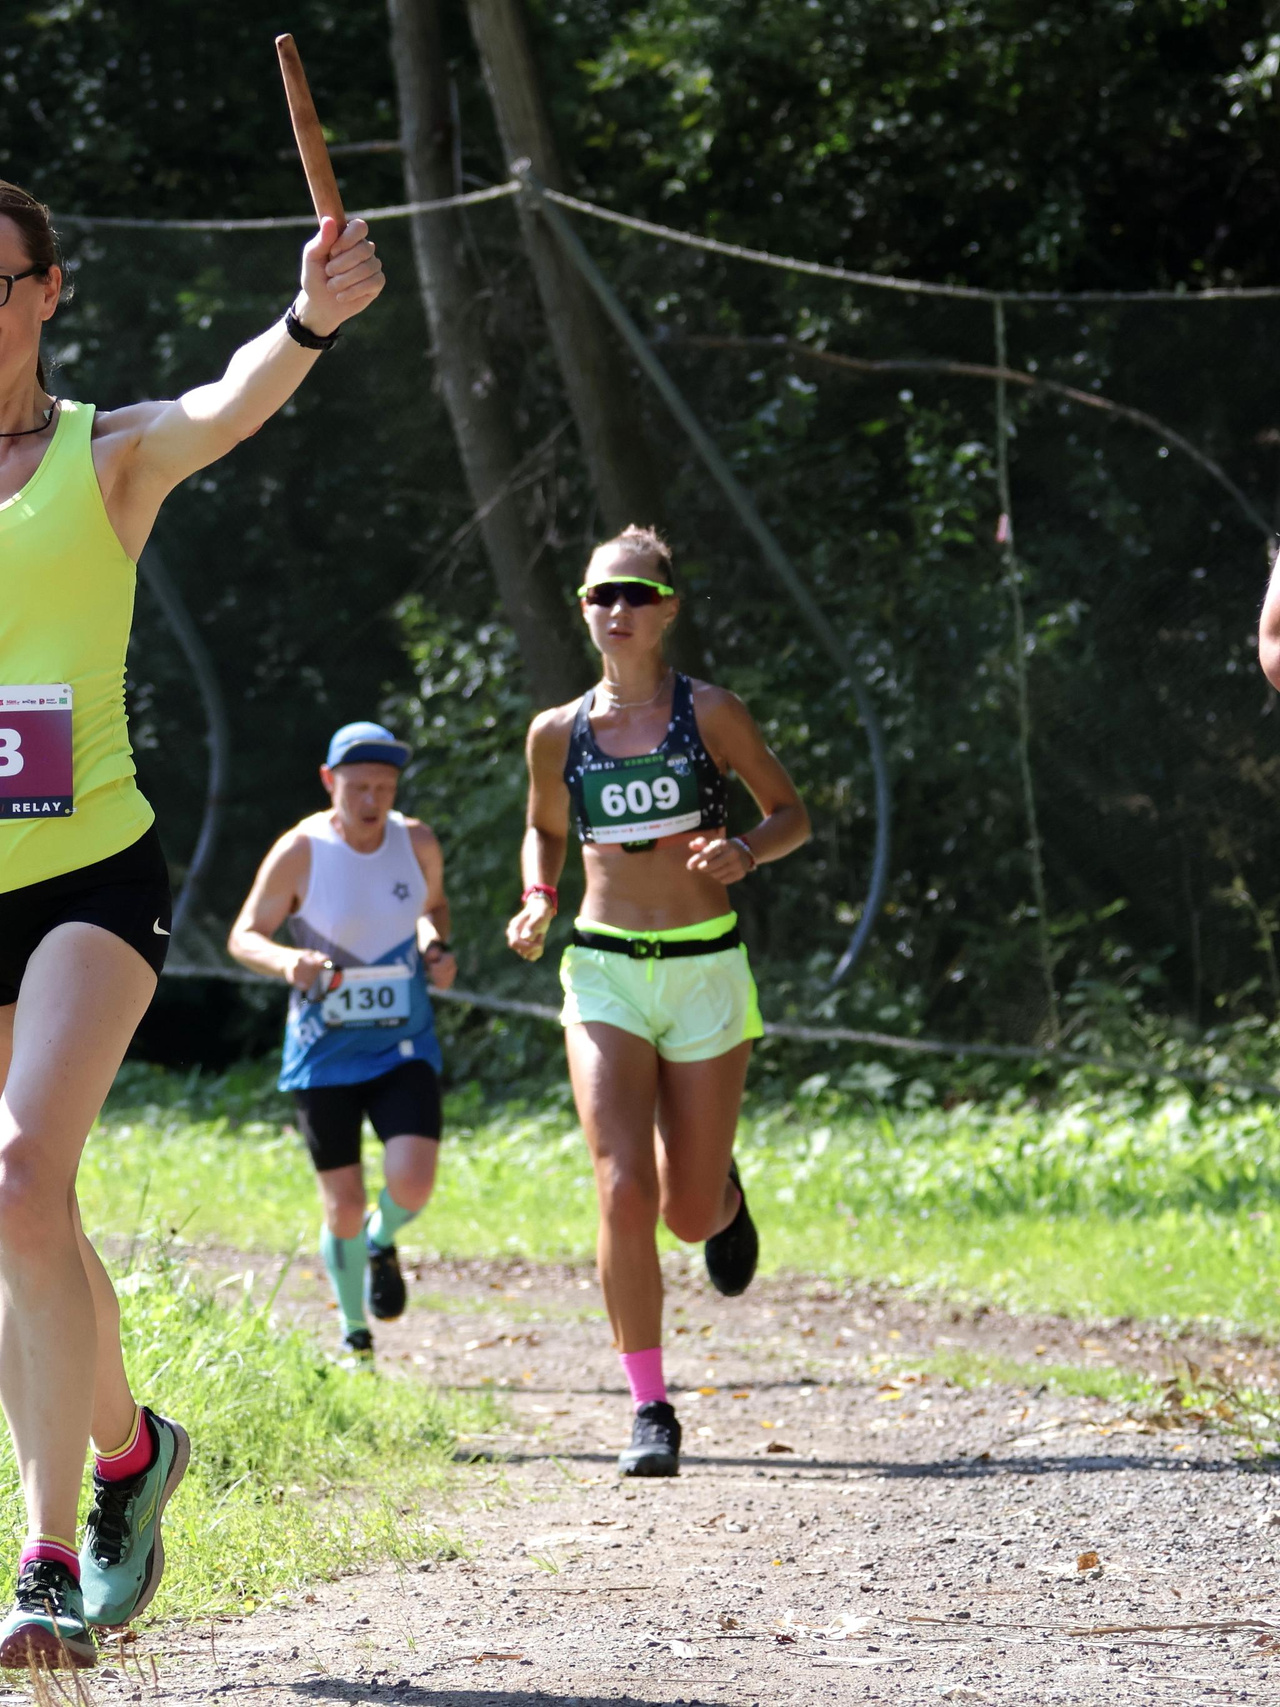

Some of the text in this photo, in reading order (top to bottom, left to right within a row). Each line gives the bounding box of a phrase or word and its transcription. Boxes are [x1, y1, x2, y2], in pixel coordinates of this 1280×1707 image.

[12, 801, 62, 813] RELAY
[600, 775, 681, 818] 609
[339, 986, 395, 1011] 130
